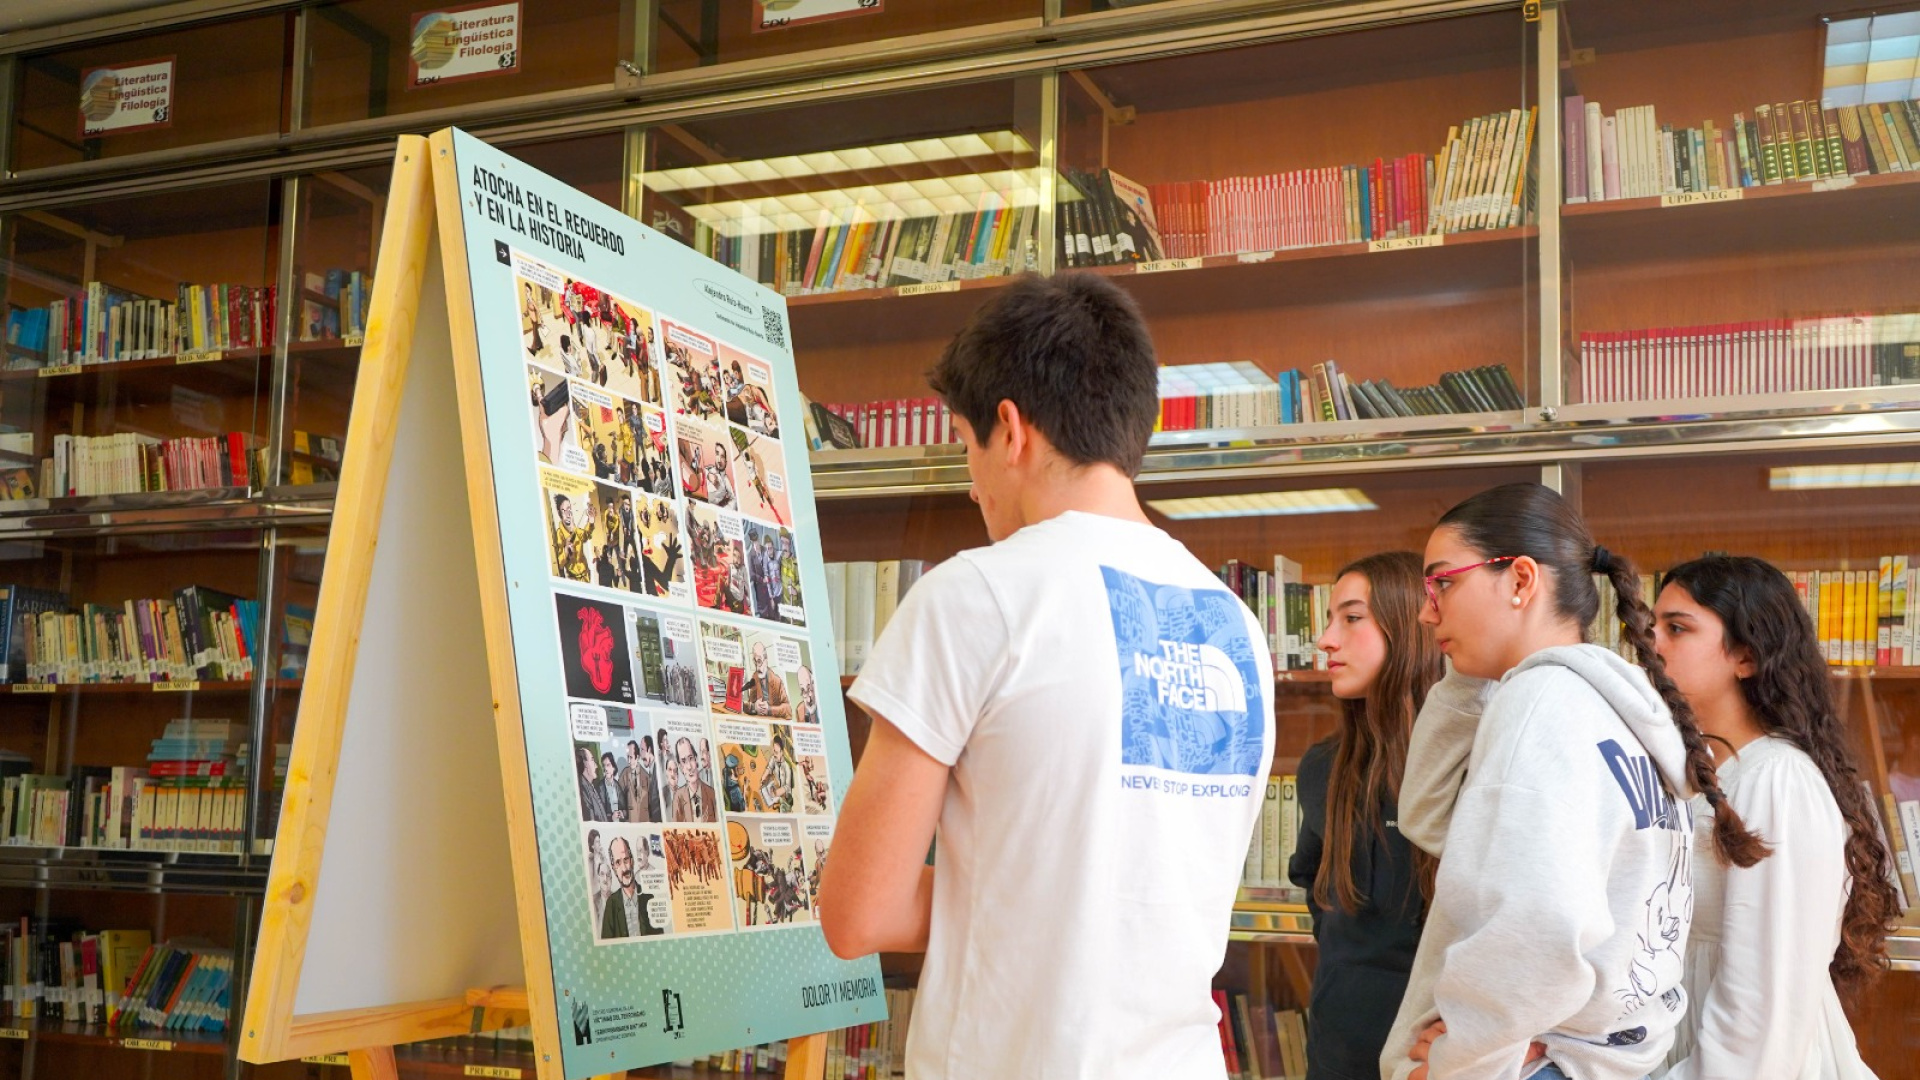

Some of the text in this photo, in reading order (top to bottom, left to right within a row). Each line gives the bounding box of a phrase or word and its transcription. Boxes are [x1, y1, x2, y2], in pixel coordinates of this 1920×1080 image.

[1525, 2, 1538, 20] 9
[452, 14, 514, 32] Literatura
[444, 28, 514, 47] Lingüística
[459, 42, 513, 58] Filología
[502, 53, 512, 67] 8
[115, 72, 168, 87] Literatura
[108, 86, 167, 101] Lingüística
[121, 98, 166, 112] Filología
[155, 107, 165, 120] 8
[1668, 194, 1692, 205] UPD
[1702, 190, 1727, 201] VEG
[473, 164, 625, 256] ATOCHA EN EL RECUERDO
[474, 191, 586, 263] Y EN LA HISTORIA
[1376, 240, 1392, 250] SIL
[1407, 237, 1424, 247] STI
[1142, 262, 1161, 271] SHE
[1171, 259, 1188, 269] SIK
[1159, 639, 1201, 664] THE
[1134, 651, 1203, 687] NORTH
[1157, 680, 1207, 711] FACE
[1163, 779, 1189, 796] STOP
[802, 977, 878, 1008] DOLOR Y MEMORIA
